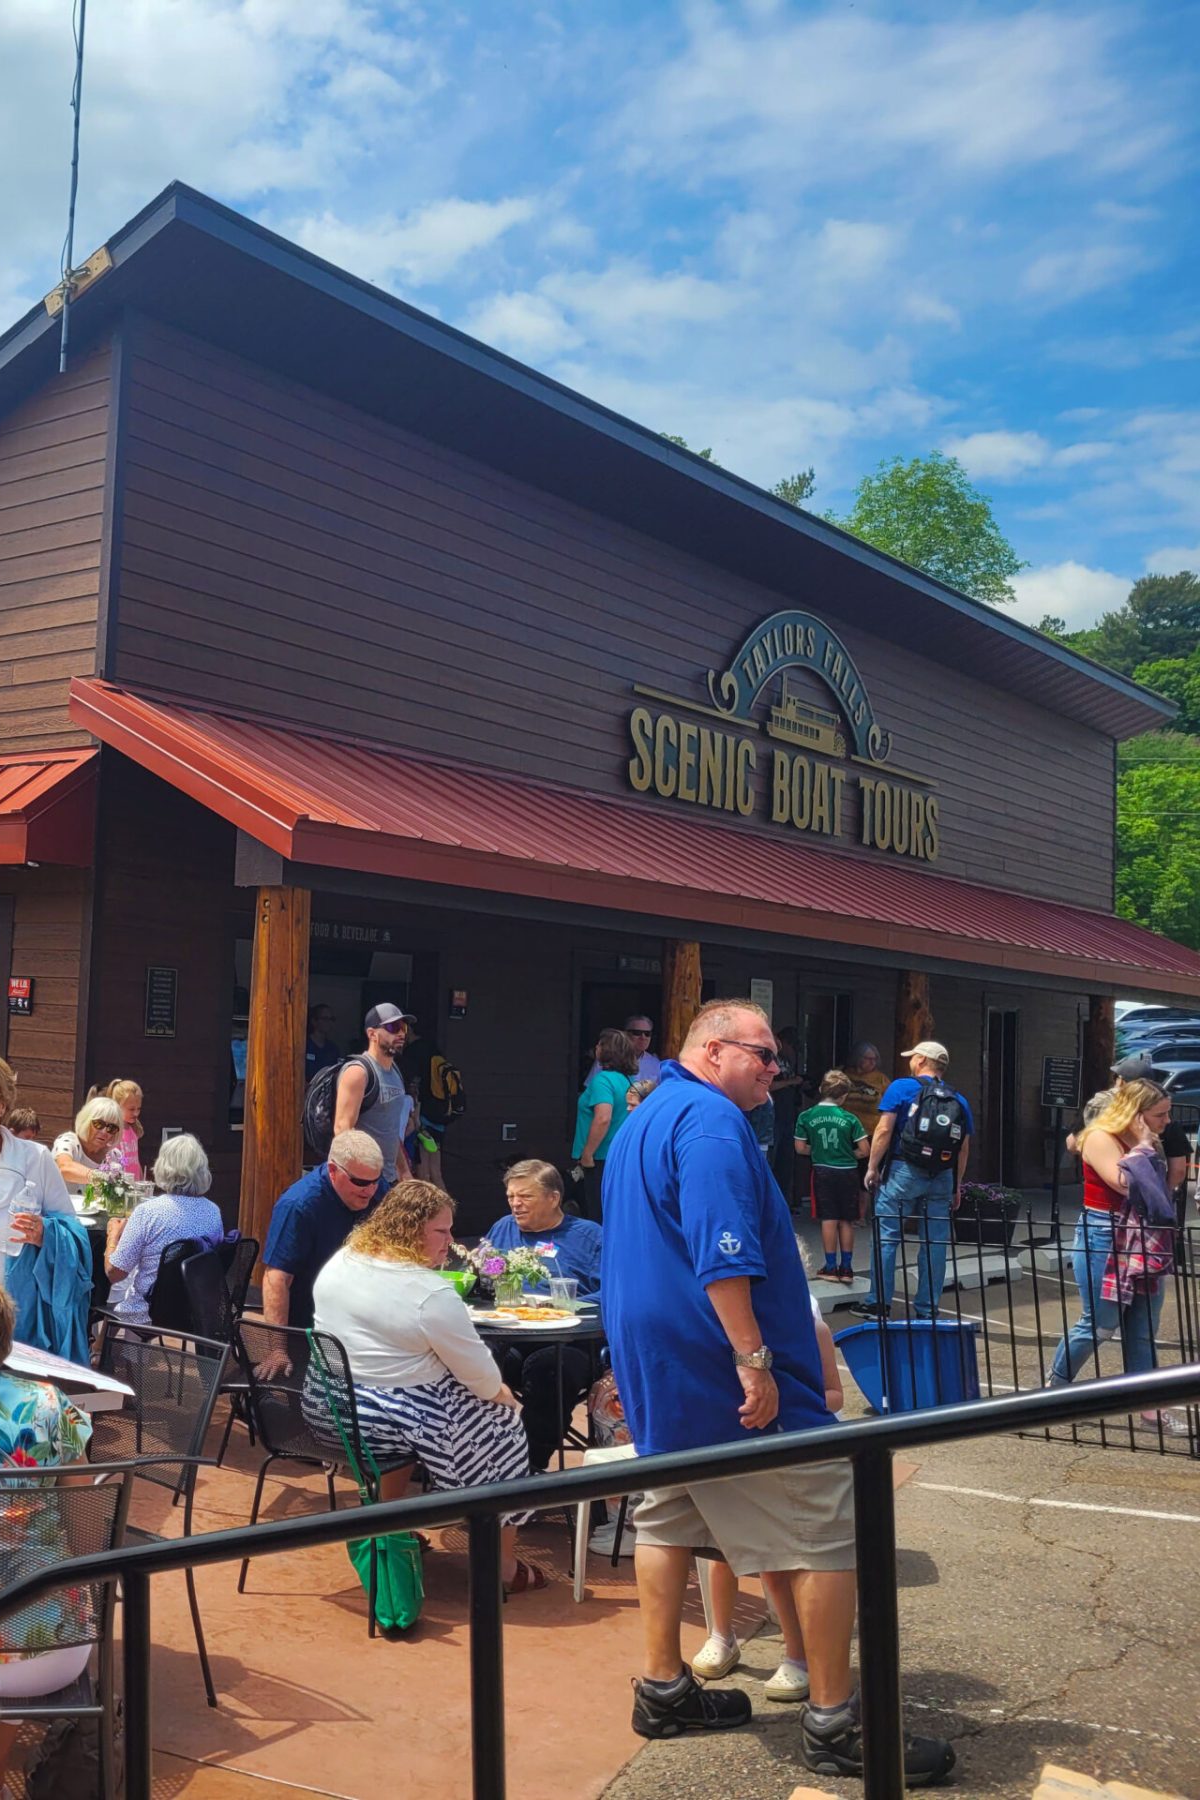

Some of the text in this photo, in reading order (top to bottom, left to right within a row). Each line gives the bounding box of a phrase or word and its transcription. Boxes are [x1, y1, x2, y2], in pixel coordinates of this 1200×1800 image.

[742, 623, 867, 726] TAYLORS FALLS
[629, 707, 939, 862] SCENIC BOAT TOURS
[818, 1127, 840, 1149] 14
